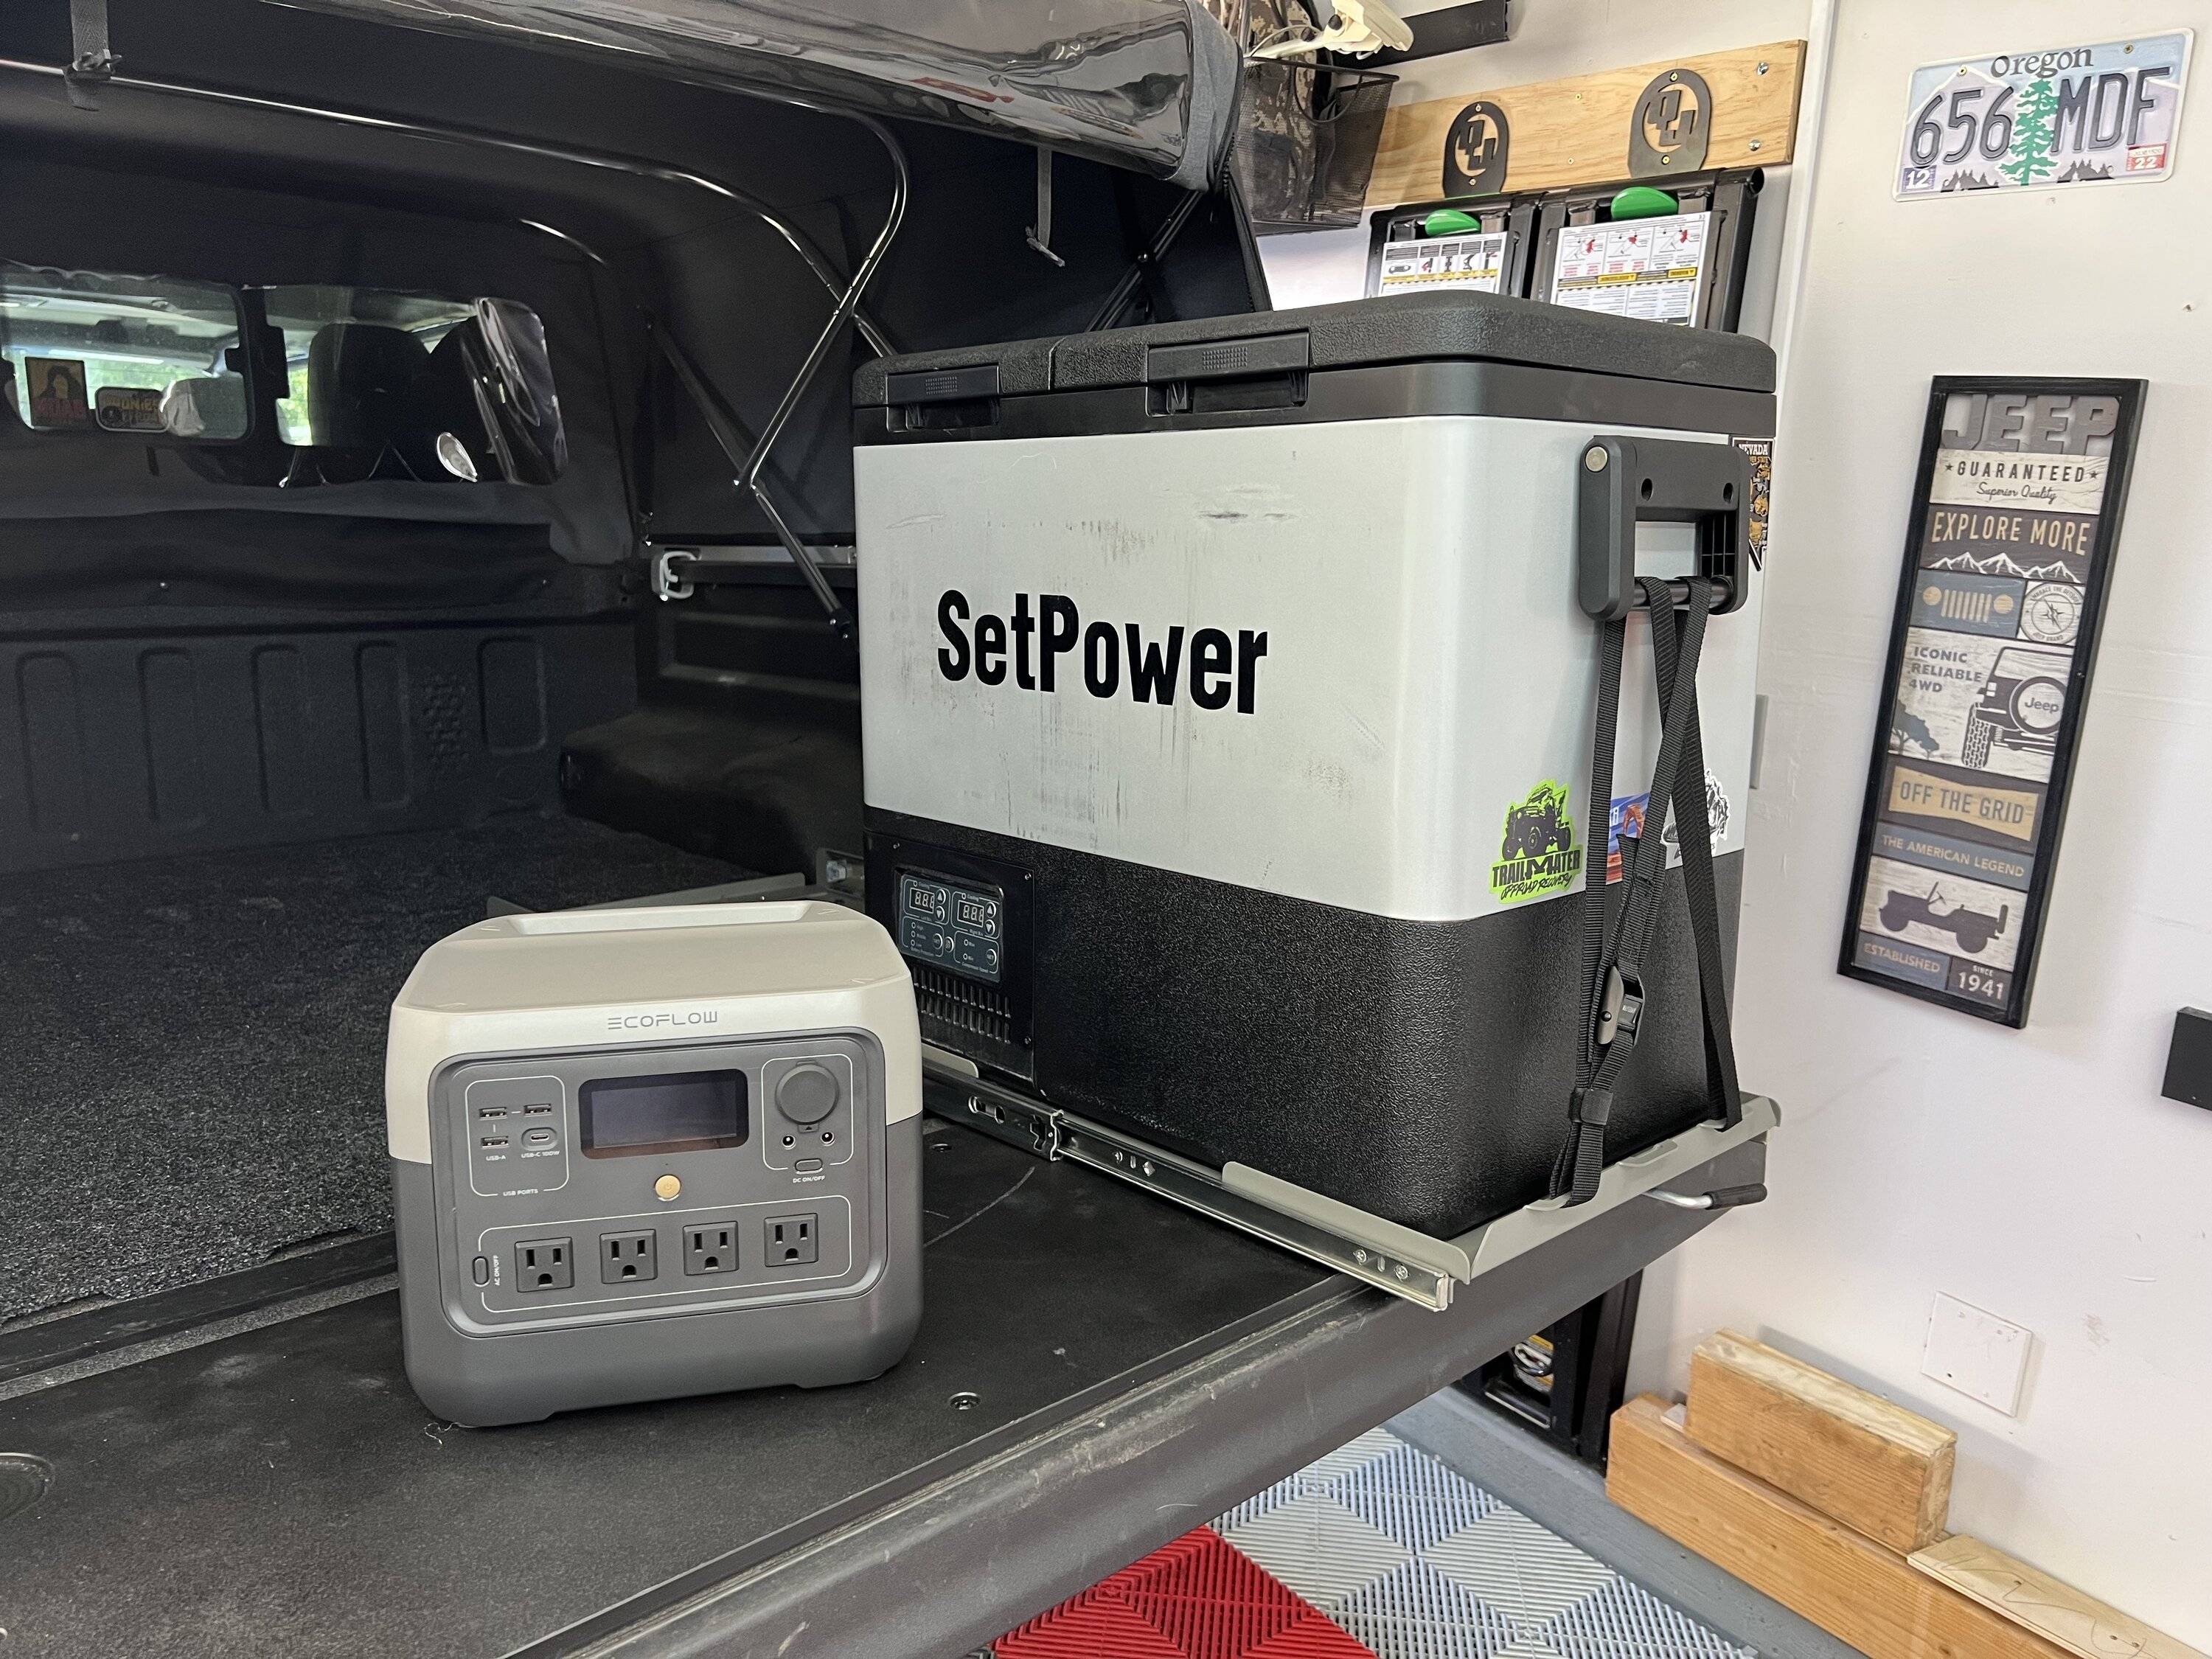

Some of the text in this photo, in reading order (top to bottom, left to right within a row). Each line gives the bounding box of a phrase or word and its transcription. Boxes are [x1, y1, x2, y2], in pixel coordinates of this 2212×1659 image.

[1991, 49, 2093, 78] Oregon
[1910, 66, 2171, 165] 656 MDF
[2134, 156, 2157, 170] 22
[1906, 170, 1930, 189] 12
[1941, 393, 2121, 456] JEEP
[1957, 460, 2085, 482] GUARANTEED
[1976, 481, 2057, 504] Superior Quality
[1931, 511, 2091, 556] EXPLORE MORE
[936, 589, 1267, 714] SetPower
[1913, 646, 1968, 664] ICONIC
[1910, 664, 1983, 682] RELIABLE
[1909, 679, 1943, 692] 4WD
[2024, 697, 2059, 714] Jeep
[1899, 781, 2025, 824] OFF THE GRID
[1882, 834, 2025, 877] THE AMERICAN LEGEND
[1863, 942, 1941, 973] ESTABLISHED
[1972, 964, 1994, 977] SINCE
[1958, 971, 2005, 1000] 1941
[608, 1011, 717, 1030] ECOFLOW
[494, 1277, 501, 1286] AC
